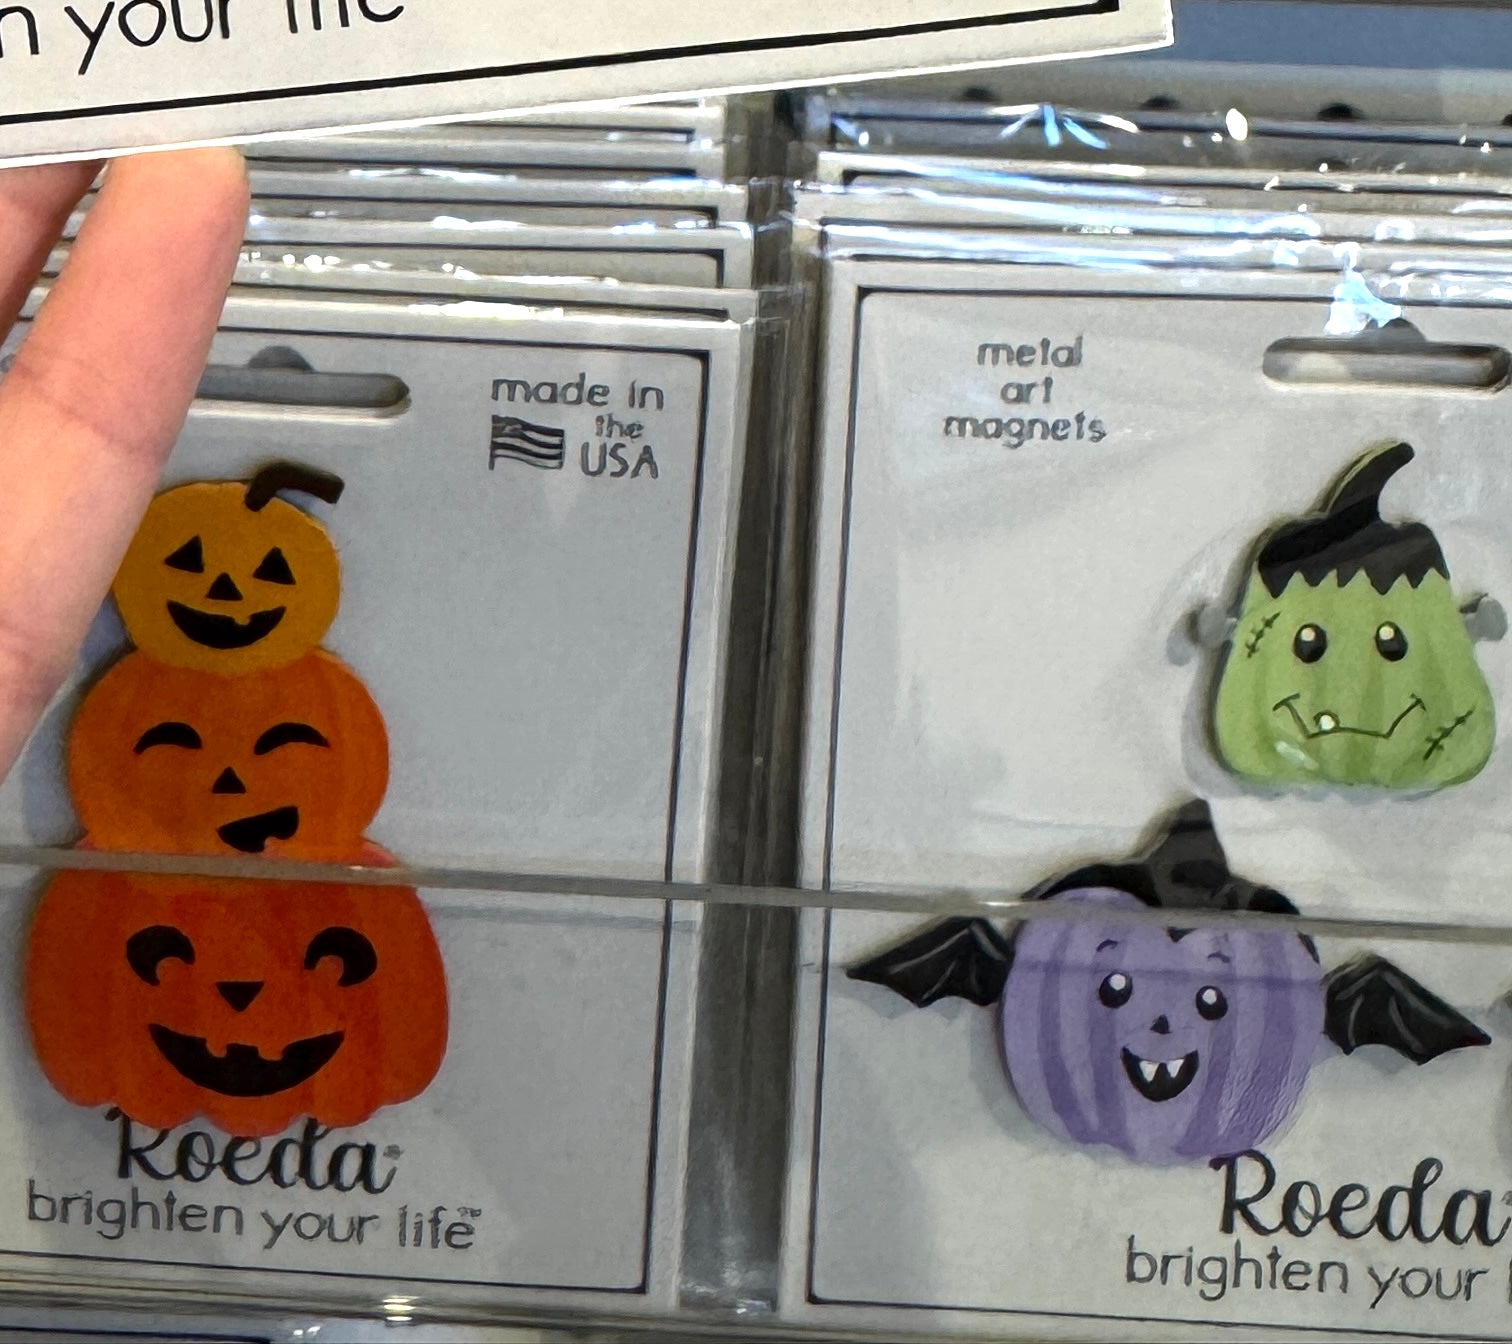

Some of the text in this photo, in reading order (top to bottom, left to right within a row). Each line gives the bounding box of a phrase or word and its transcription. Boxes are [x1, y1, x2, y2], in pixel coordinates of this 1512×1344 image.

[977, 333, 1084, 368] metal
[491, 372, 664, 411] made in
[1000, 375, 1054, 405] art
[595, 413, 645, 439] the
[944, 410, 1107, 450] magnets
[581, 442, 659, 479] USA
[27, 1178, 244, 1241] brighten
[260, 1208, 380, 1251] your
[1126, 1234, 1348, 1302] brighten
[1367, 1265, 1489, 1310] your
